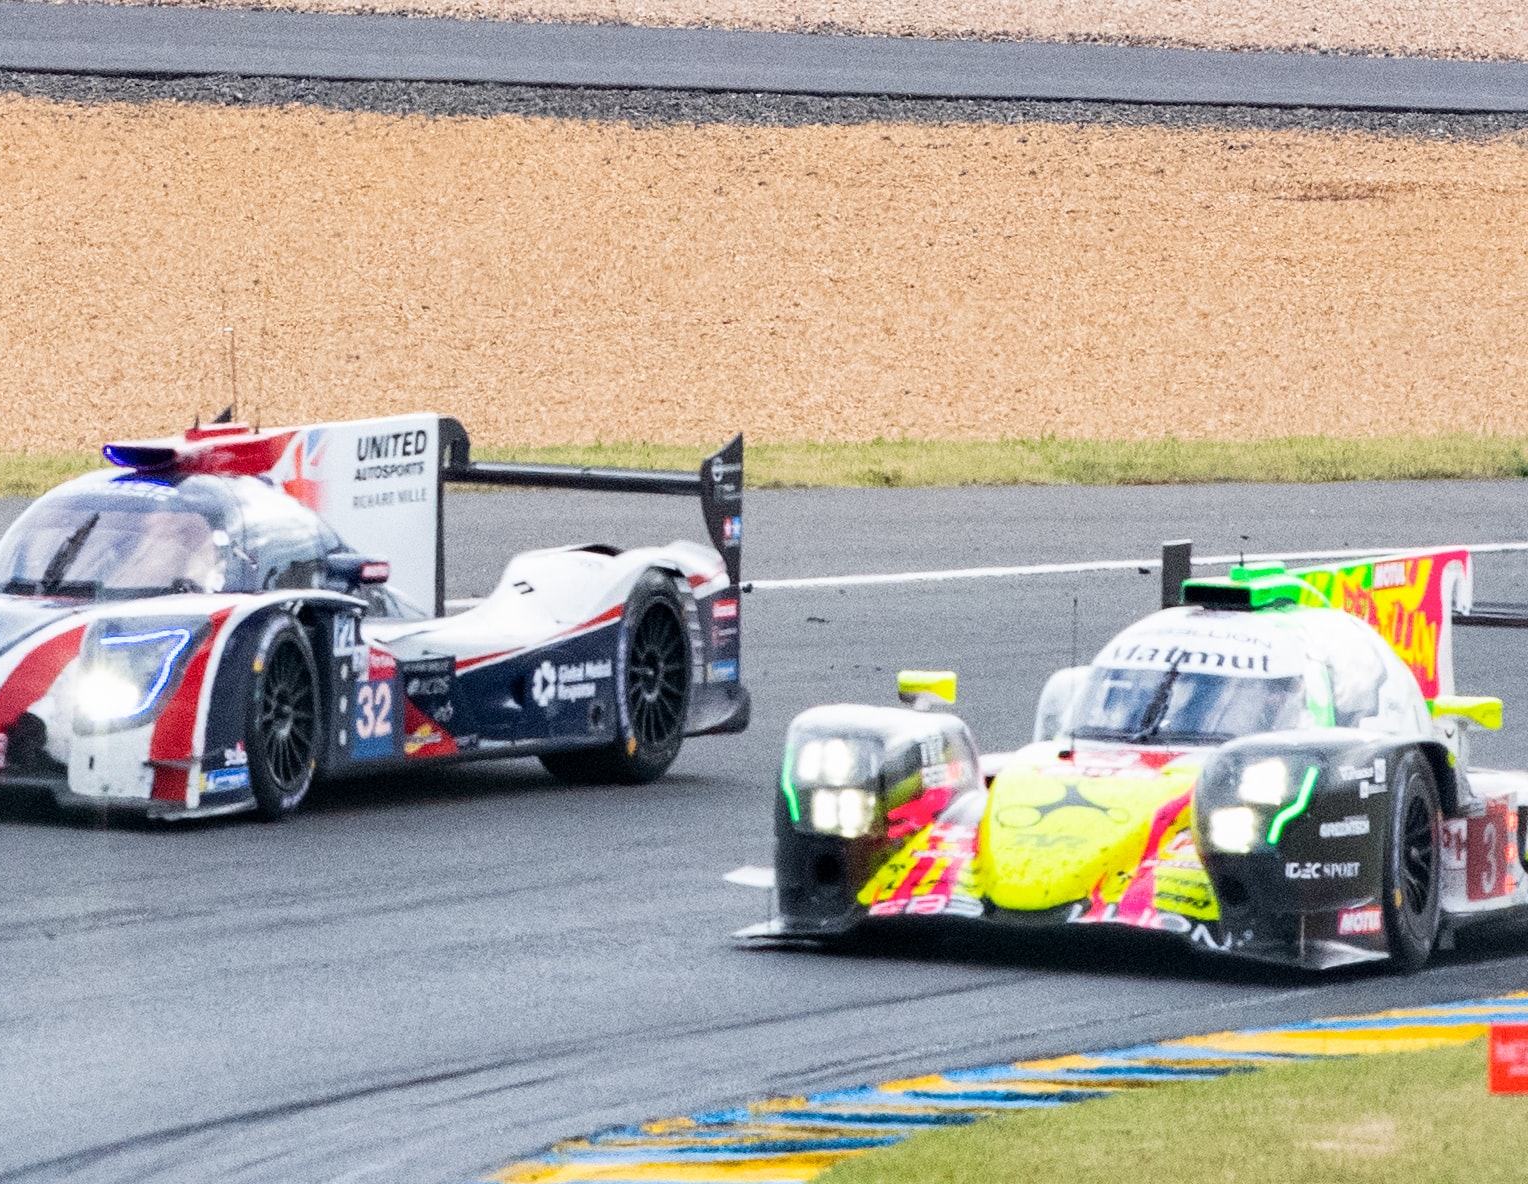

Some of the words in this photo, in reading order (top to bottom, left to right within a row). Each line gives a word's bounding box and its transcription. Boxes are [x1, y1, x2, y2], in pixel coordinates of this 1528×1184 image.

[357, 429, 427, 461] UNITED
[354, 461, 424, 480] AUTOSPORTS
[1373, 561, 1407, 590] MOTUL
[1112, 643, 1272, 673] Matmut
[355, 680, 393, 740] 32
[1481, 812, 1499, 894] 3
[1284, 862, 1322, 880] IDEC
[1323, 862, 1361, 879] SPORT
